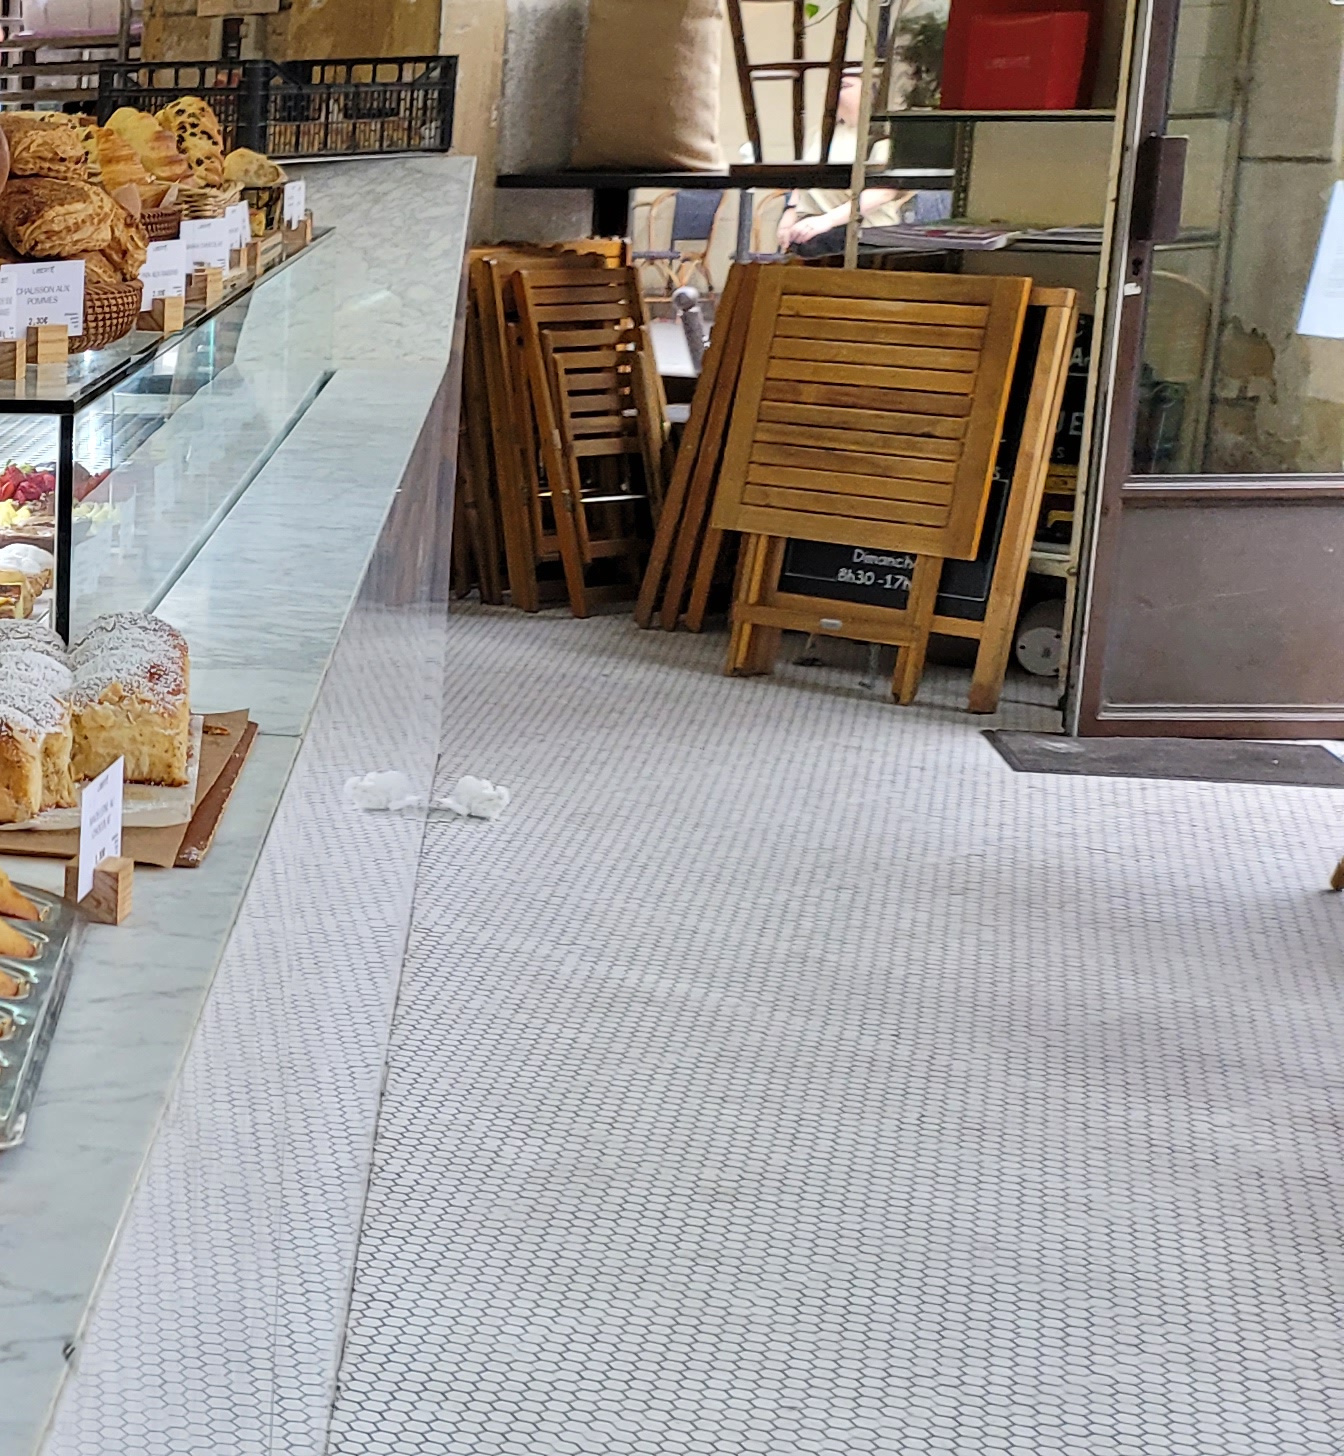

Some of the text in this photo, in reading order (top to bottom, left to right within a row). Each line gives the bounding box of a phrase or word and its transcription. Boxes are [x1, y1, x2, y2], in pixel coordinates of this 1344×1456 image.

[26, 295, 59, 306] POMMES
[853, 549, 917, 570] Dimanch
[837, 568, 875, 585] 8h30
